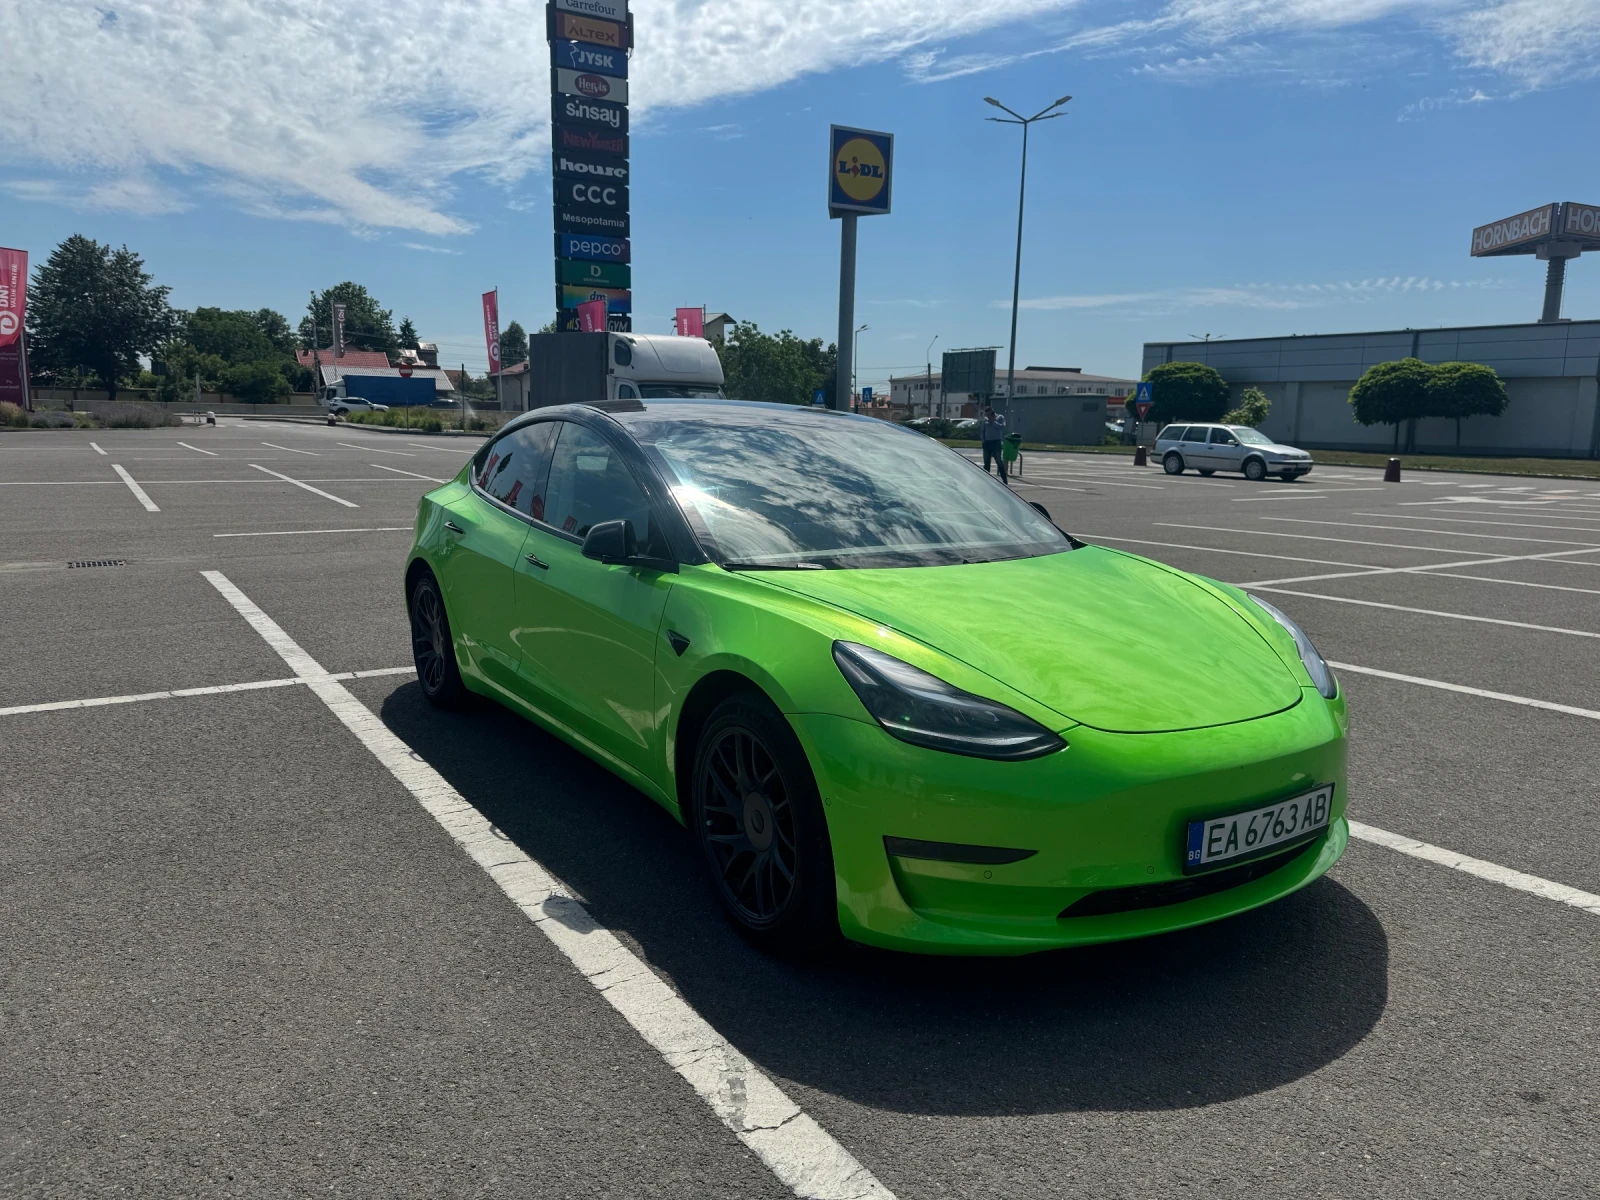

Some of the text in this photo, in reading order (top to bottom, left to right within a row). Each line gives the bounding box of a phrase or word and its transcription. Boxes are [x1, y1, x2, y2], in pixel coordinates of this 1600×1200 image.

[566, 0, 616, 15] Carrefour
[578, 51, 614, 68] JYSK
[578, 78, 608, 93] Hervis
[566, 100, 620, 128] sinsay
[560, 158, 628, 178] house
[572, 184, 617, 206] CCC
[562, 213, 625, 228] Mesopotamia
[1472, 209, 1551, 251] HORNBACH
[570, 240, 621, 256] pepco
[590, 265, 602, 277] D
[607, 320, 629, 332] GYM
[1207, 793, 1327, 858] EA 6763 AB
[1188, 850, 1200, 861] BG
